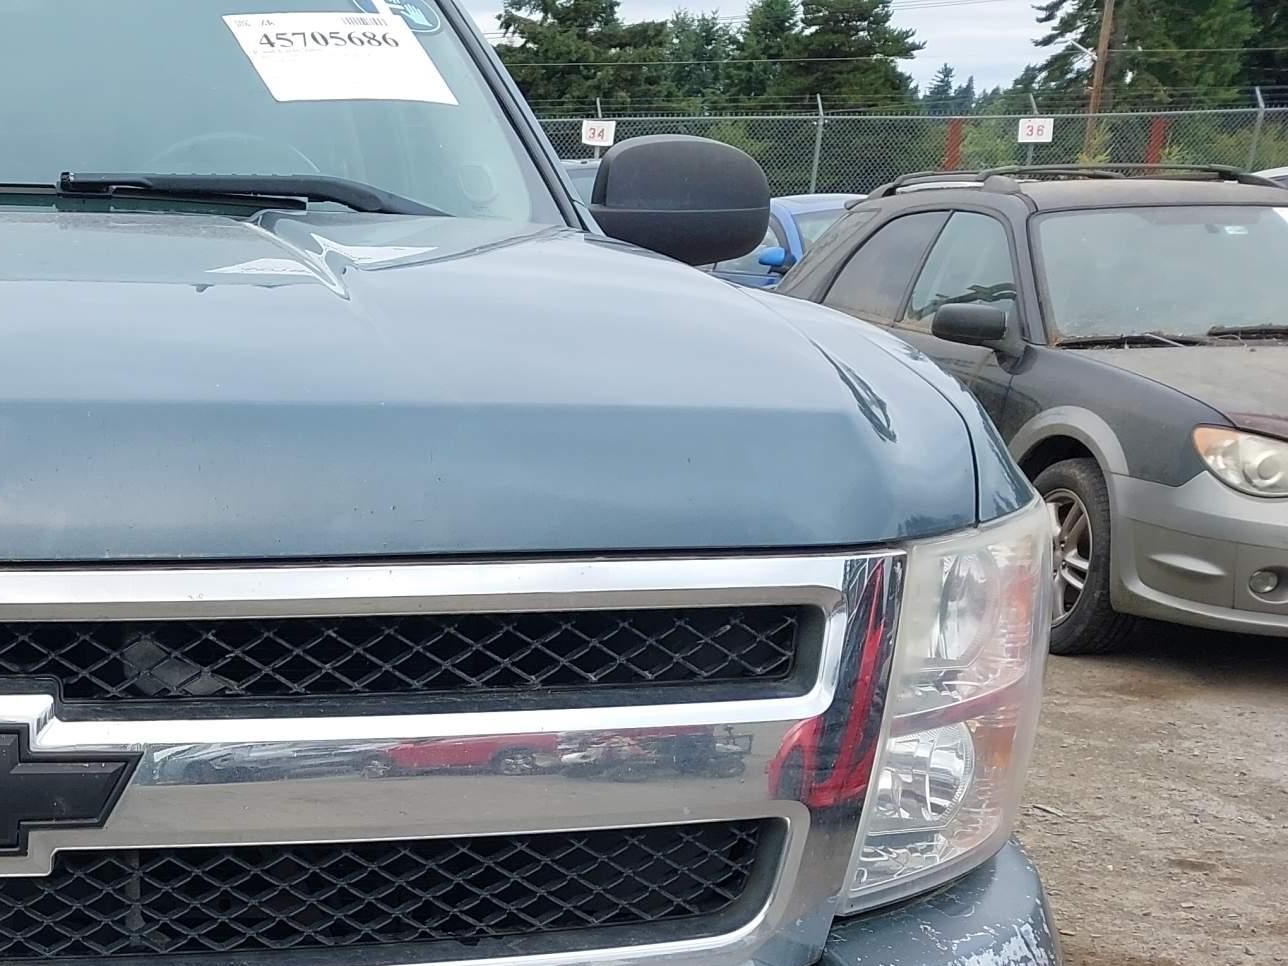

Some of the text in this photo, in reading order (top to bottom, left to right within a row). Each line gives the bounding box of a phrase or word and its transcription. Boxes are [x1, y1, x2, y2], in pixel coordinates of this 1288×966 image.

[258, 31, 400, 48] 45705686
[588, 127, 605, 140] 34
[1026, 124, 1045, 137] 36
